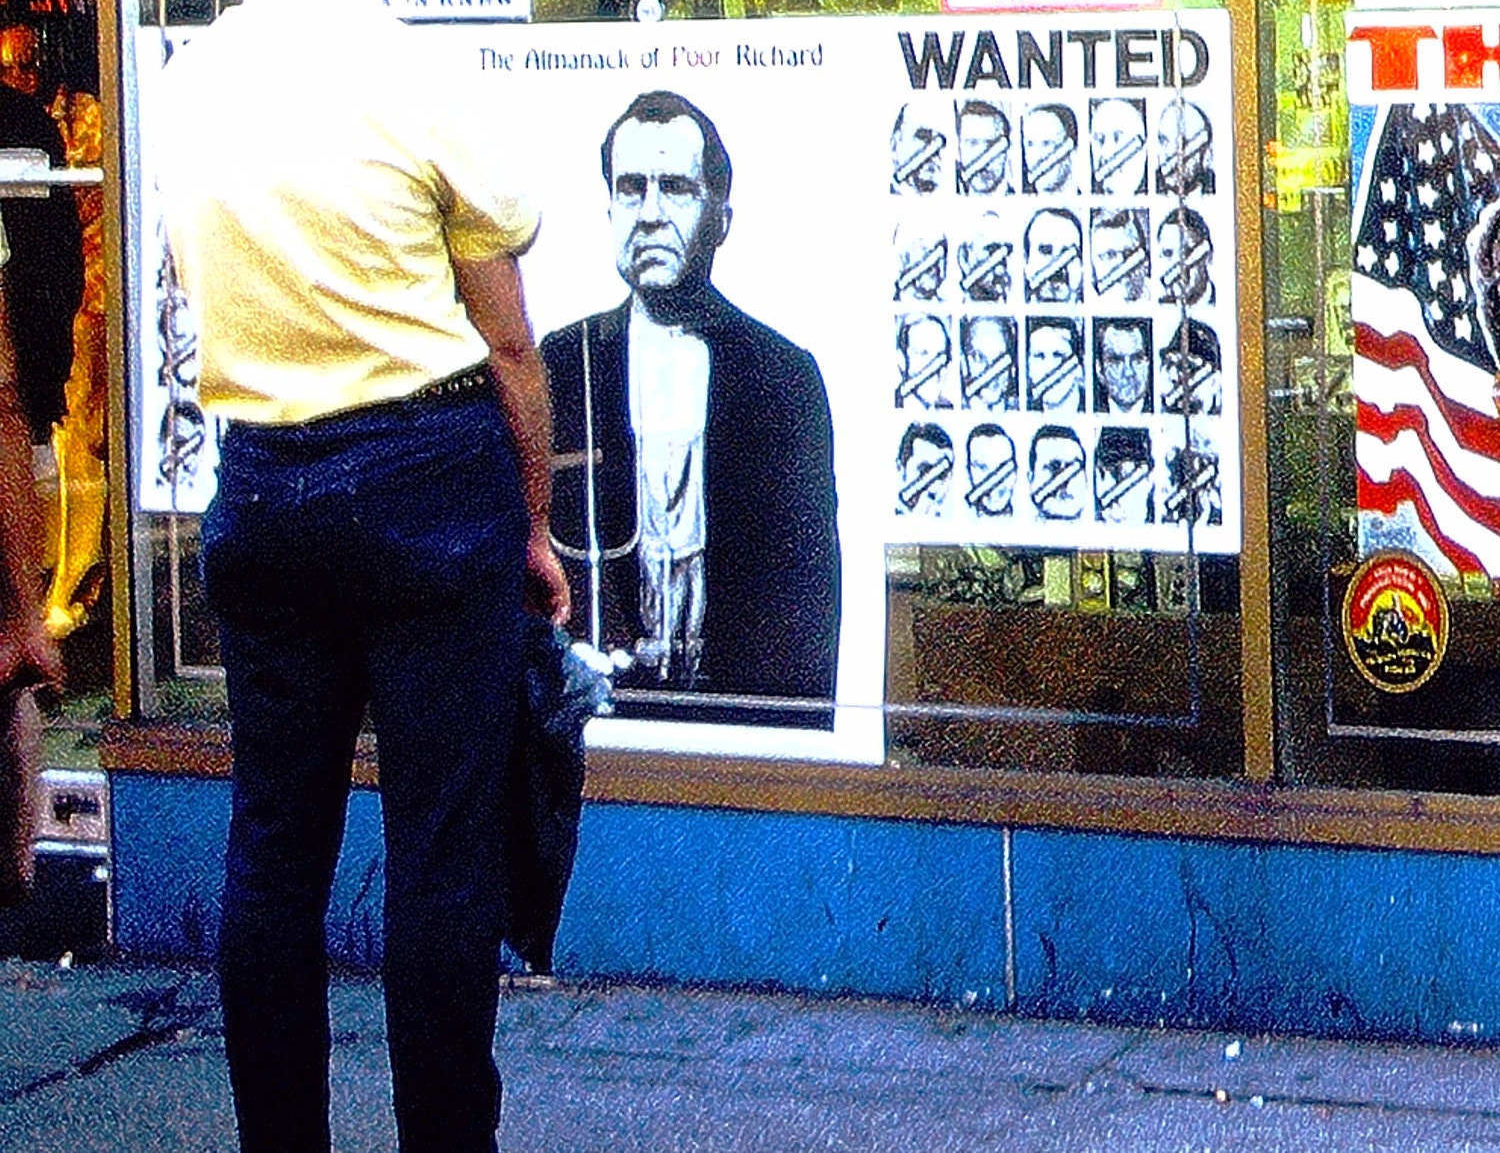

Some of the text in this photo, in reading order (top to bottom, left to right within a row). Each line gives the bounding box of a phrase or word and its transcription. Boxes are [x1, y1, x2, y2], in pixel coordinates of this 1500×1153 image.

[480, 43, 823, 72] The Almanack of Poor Richard
[897, 28, 1210, 90] WANTED
